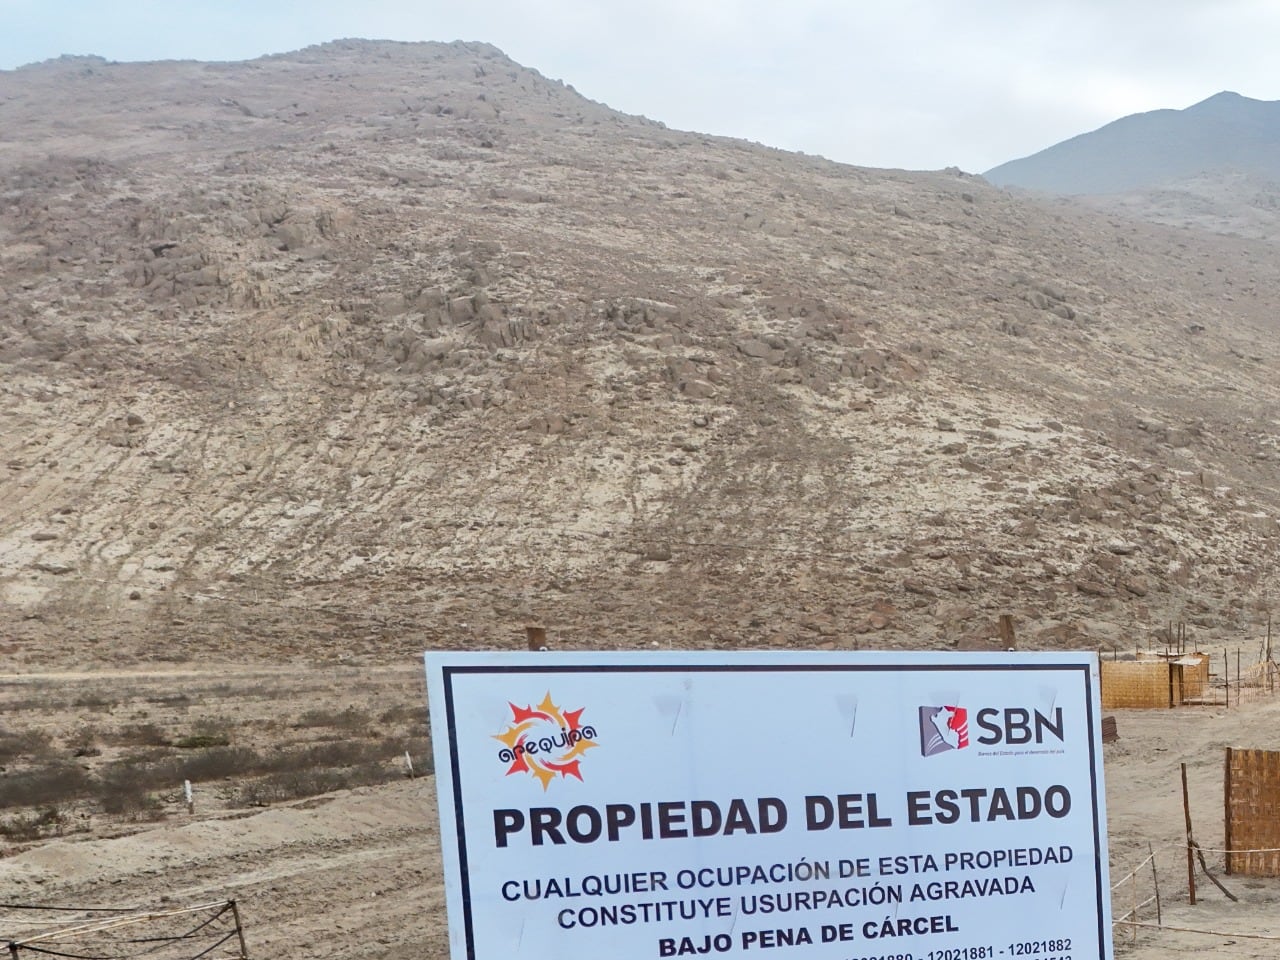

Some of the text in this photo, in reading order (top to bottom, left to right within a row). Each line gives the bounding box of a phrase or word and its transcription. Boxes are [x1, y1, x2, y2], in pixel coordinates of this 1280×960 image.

[977, 708, 1064, 745] SBN
[493, 785, 1071, 848] PROPIEDAD DEL ESTADO
[502, 846, 1072, 901] CUALQUIER OCUPACIÓN DE ESTA PROPIEDAD
[558, 876, 1035, 929] CONSTITUYE USURPACIÓN AGRAVADA
[659, 916, 958, 957] BAJO PENA DE CÁRCEL
[1008, 938, 1072, 957] 12021882
